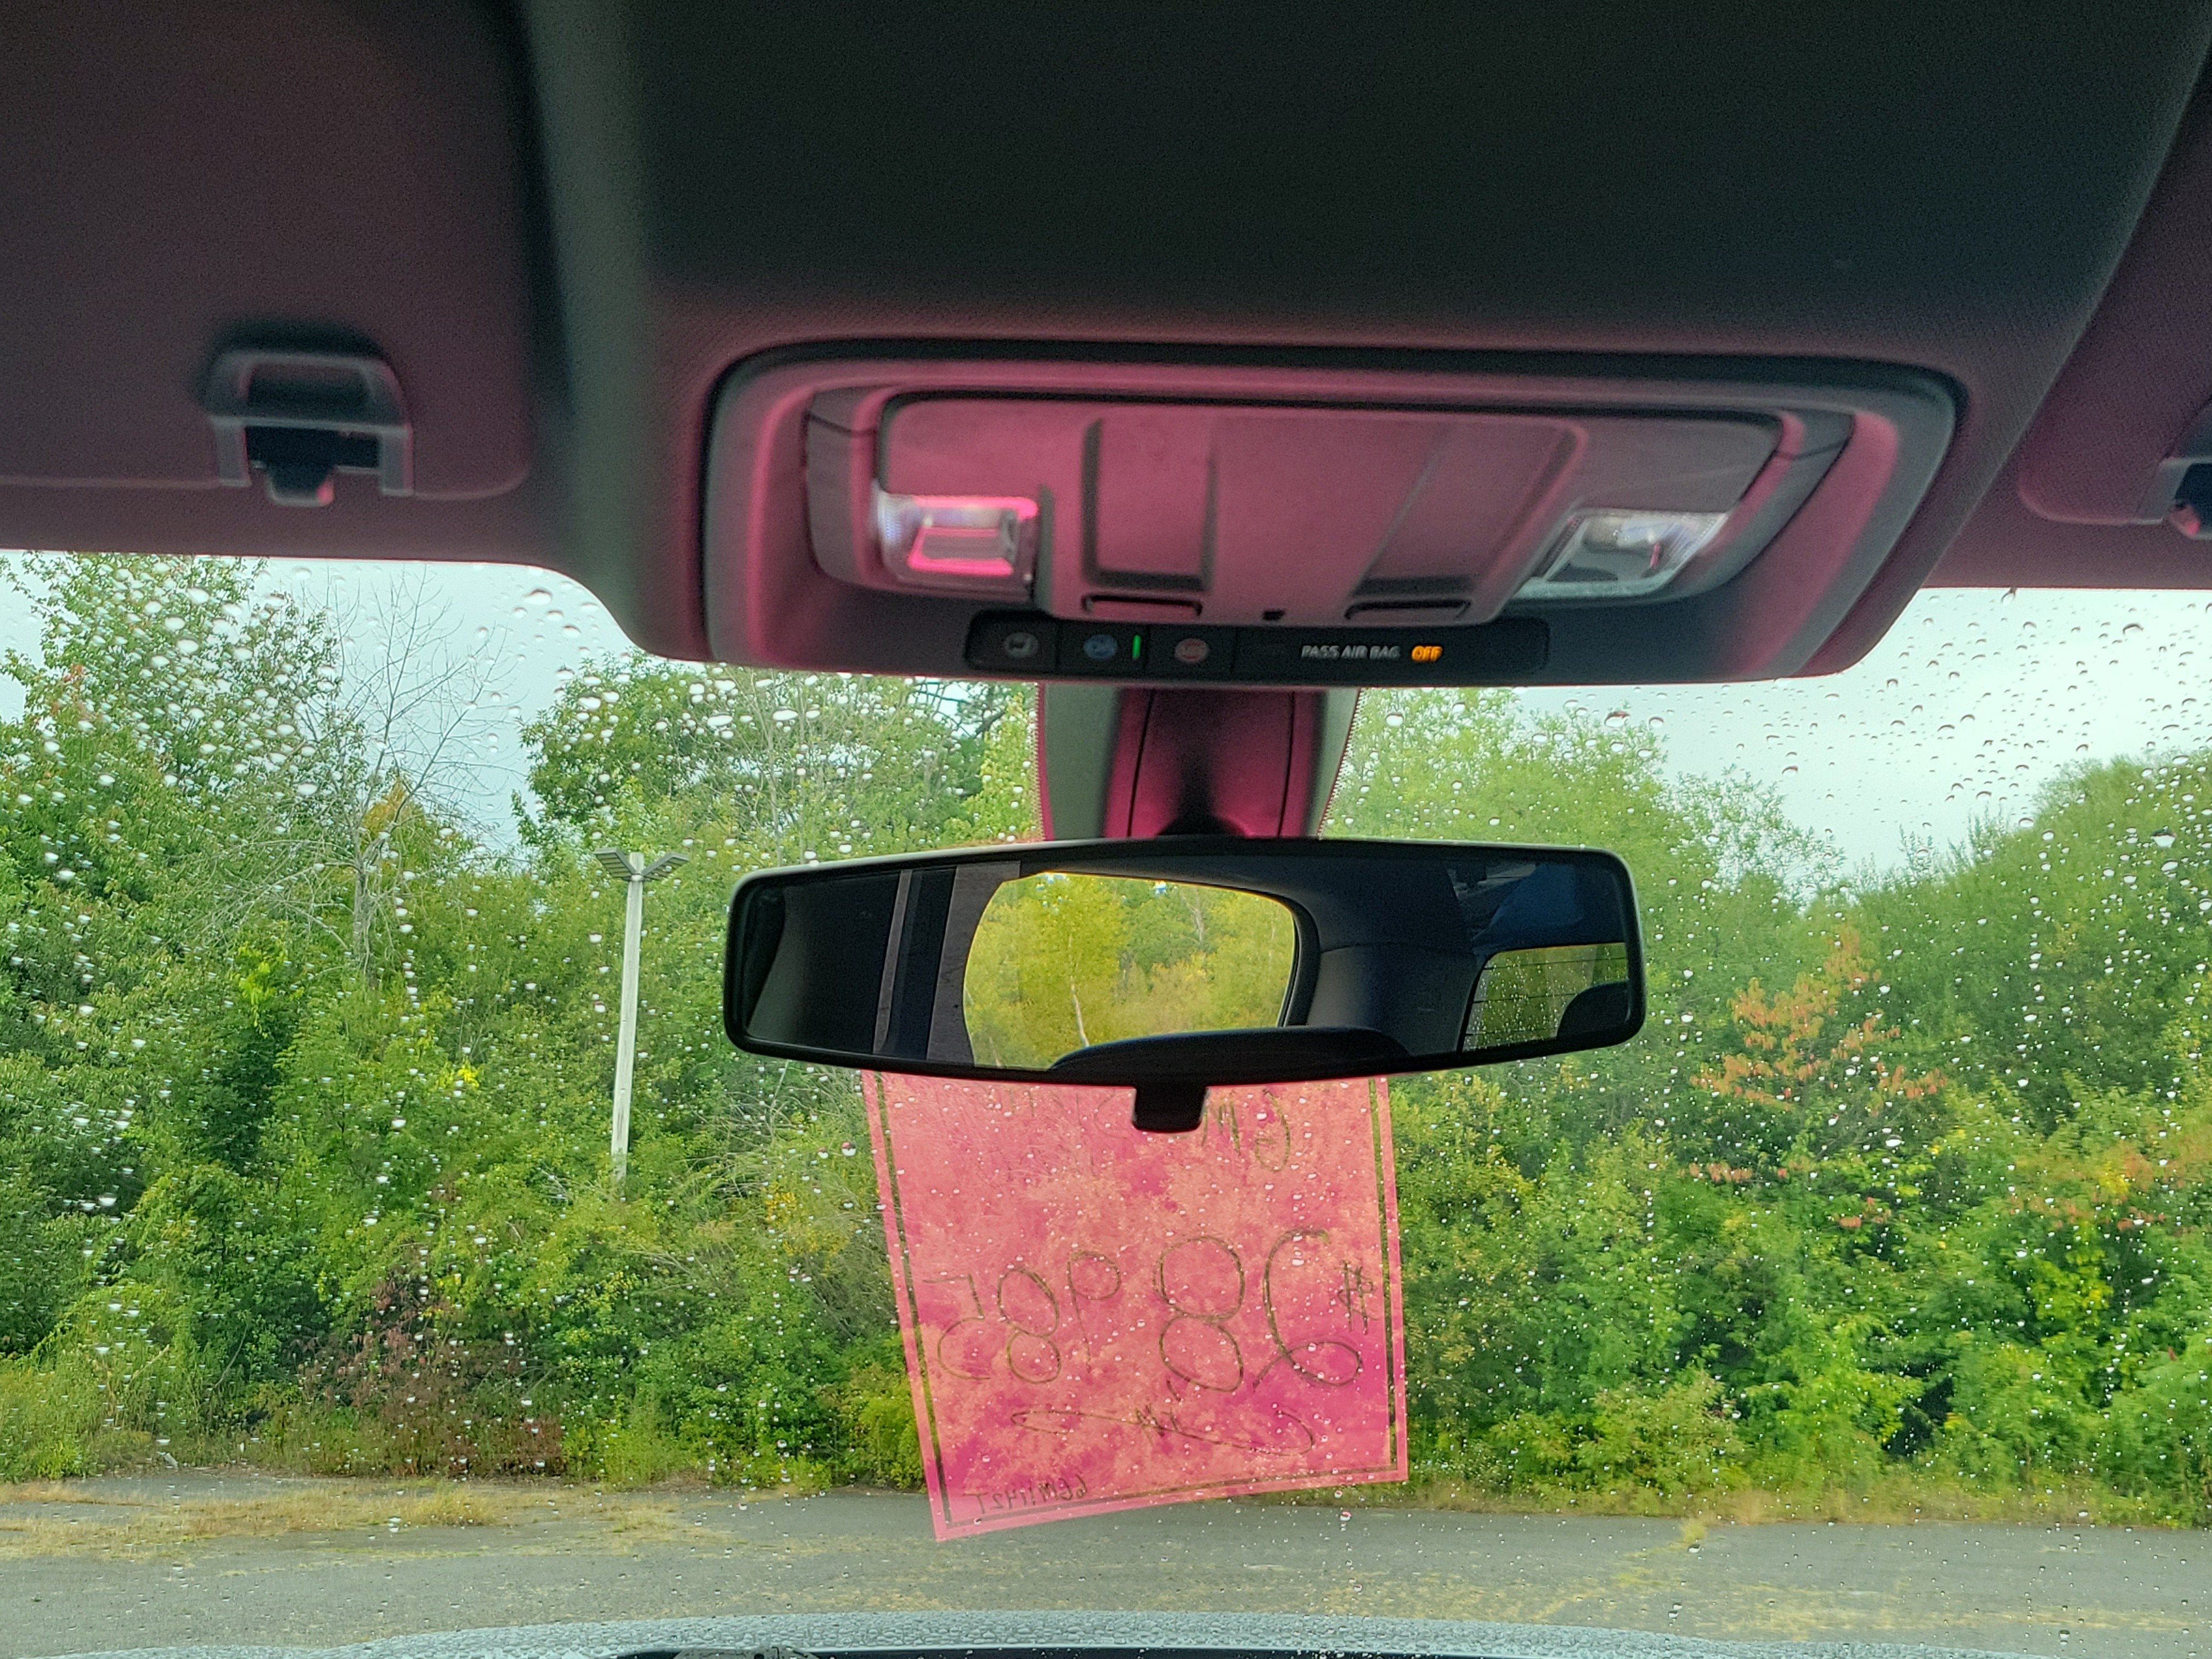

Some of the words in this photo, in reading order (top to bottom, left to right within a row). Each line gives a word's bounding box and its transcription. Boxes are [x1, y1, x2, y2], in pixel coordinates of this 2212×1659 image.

[1301, 645, 1340, 658] PASS
[1341, 645, 1368, 659] AIR
[1370, 645, 1401, 659] BAG
[1412, 645, 1443, 662] OFF
